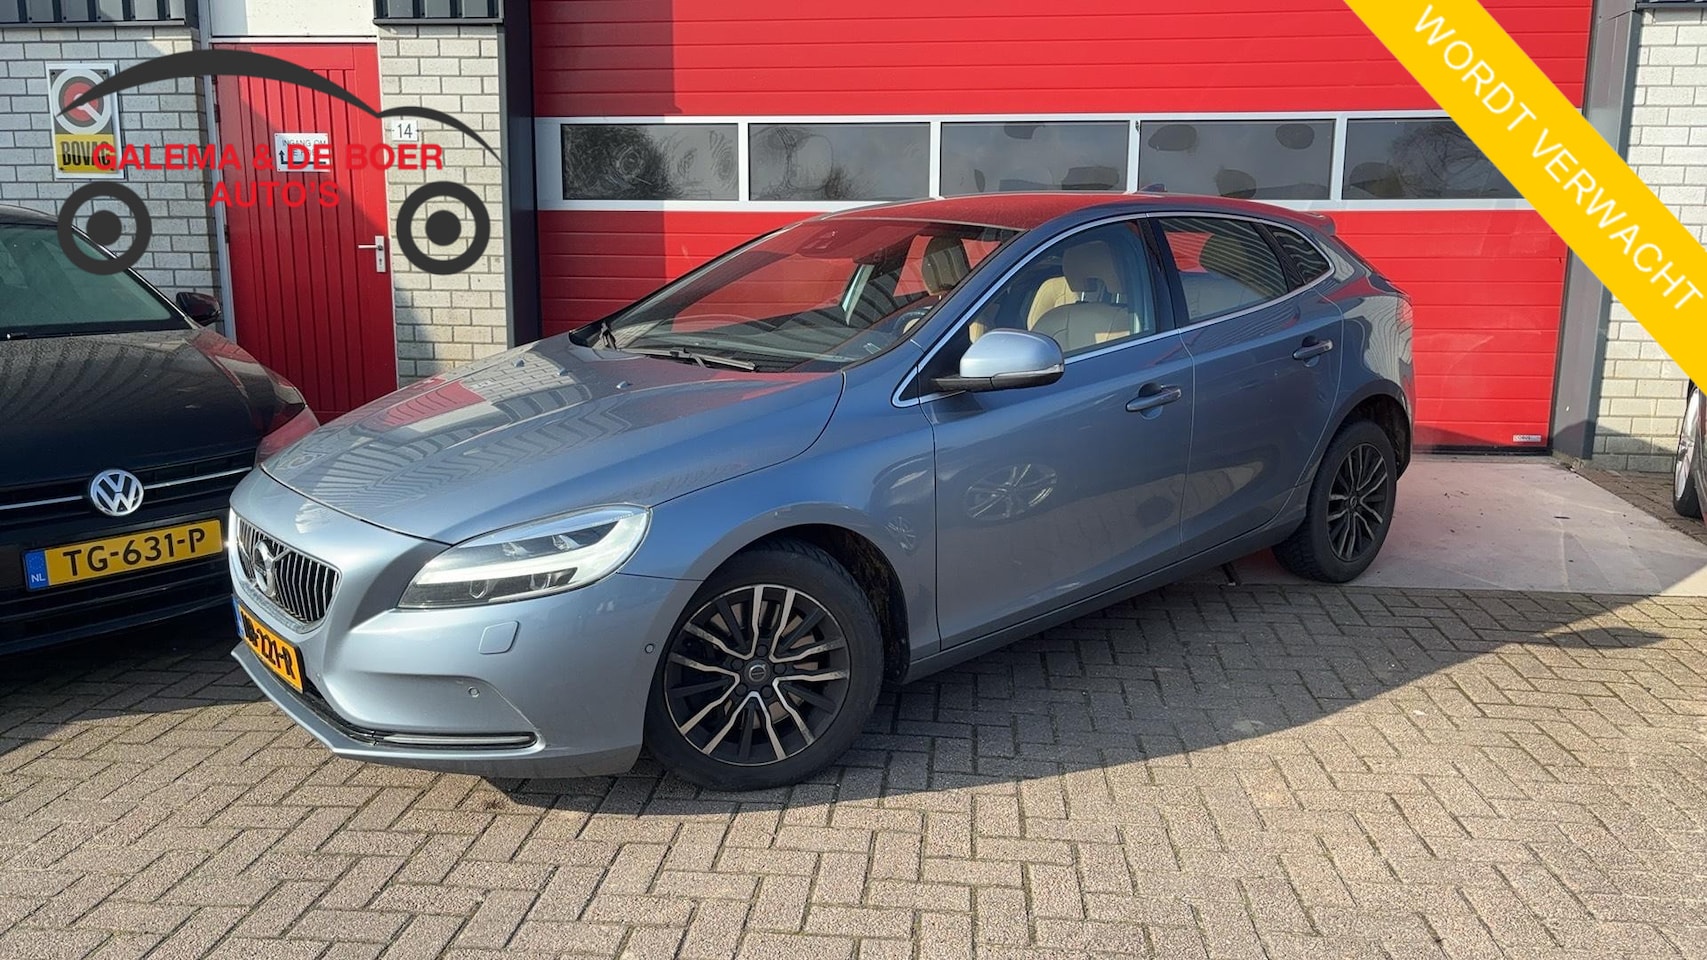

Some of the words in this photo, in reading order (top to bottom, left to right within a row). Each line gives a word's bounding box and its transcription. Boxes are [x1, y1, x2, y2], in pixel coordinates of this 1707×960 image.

[397, 123, 413, 138] 14
[31, 572, 46, 583] NL
[63, 528, 206, 576] TG-631-P
